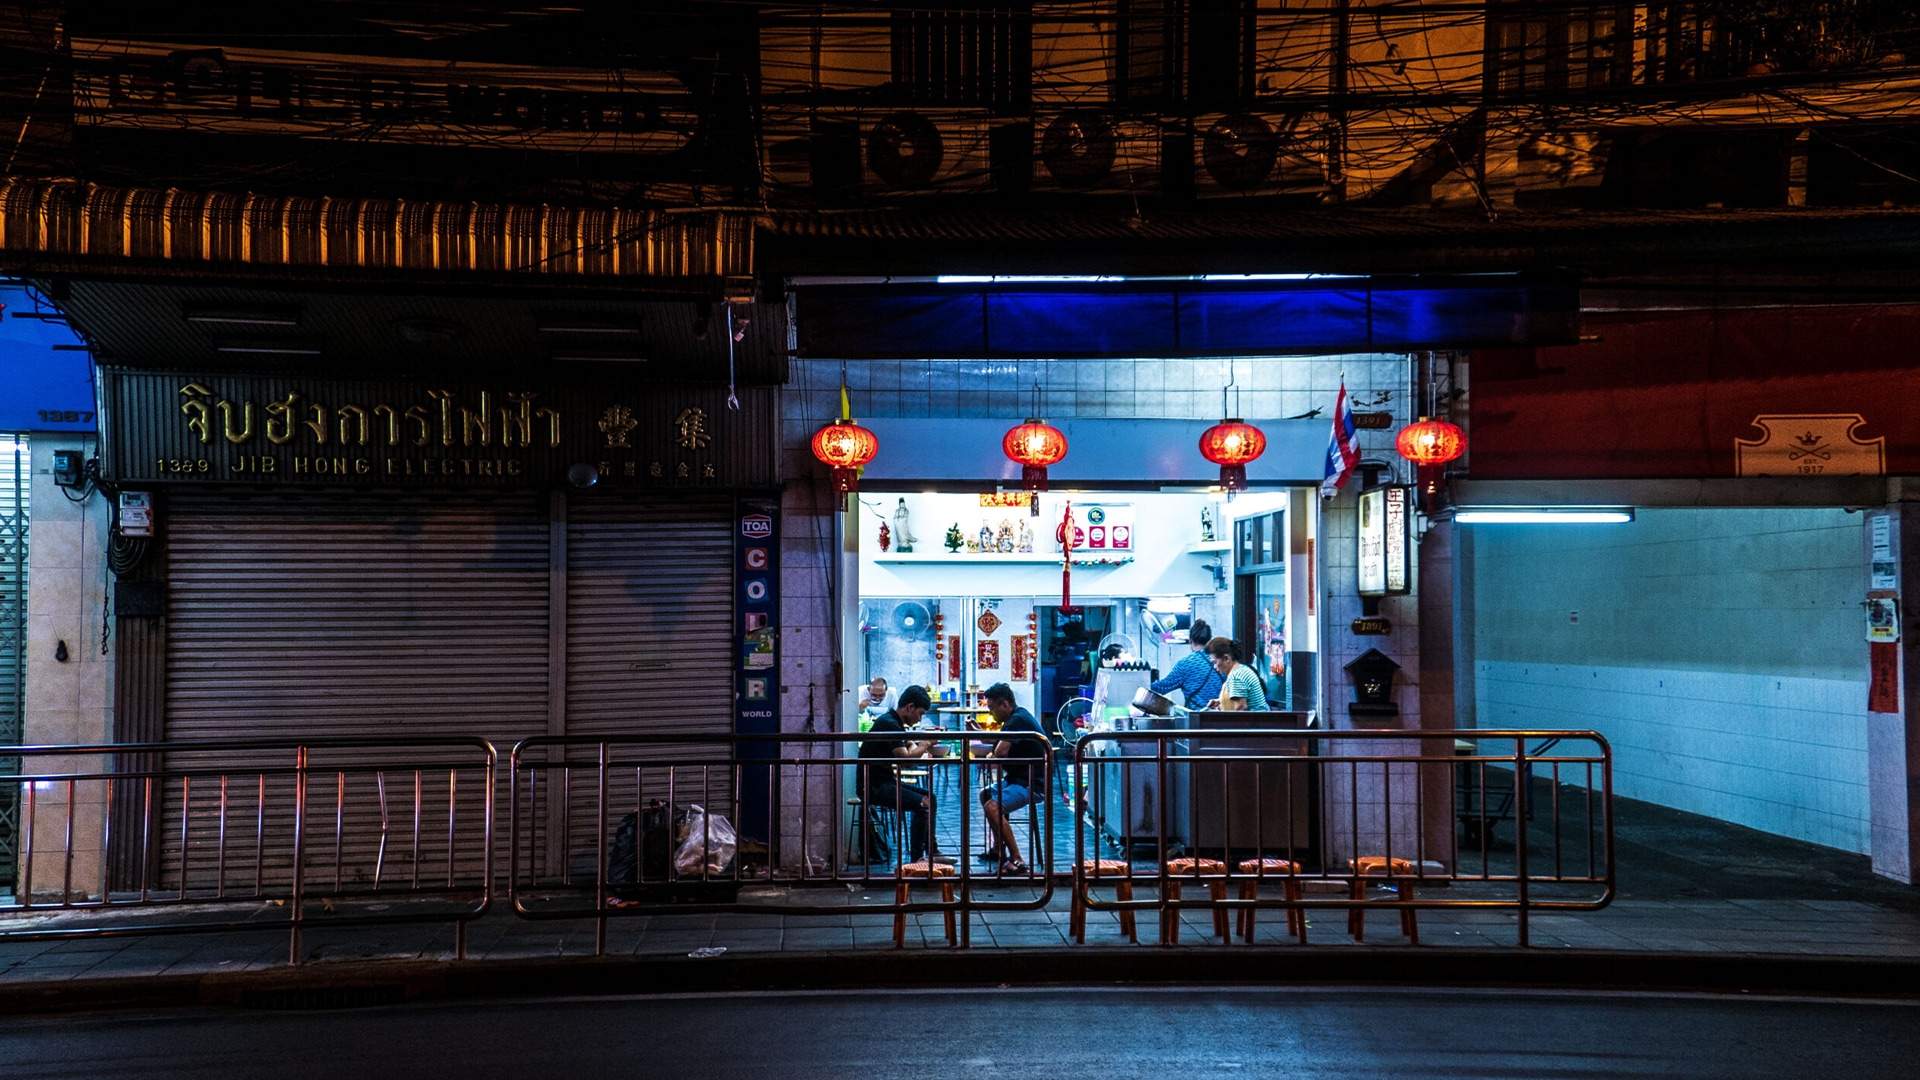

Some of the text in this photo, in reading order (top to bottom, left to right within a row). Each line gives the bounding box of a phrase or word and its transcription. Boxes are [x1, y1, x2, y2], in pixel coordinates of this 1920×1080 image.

[38, 410, 94, 423] 1387
[156, 455, 523, 477] 1389 JIB HONG ELECTRIC
[1797, 465, 1824, 474] 1917
[744, 521, 769, 531] TOA
[742, 710, 772, 718] WORLD
